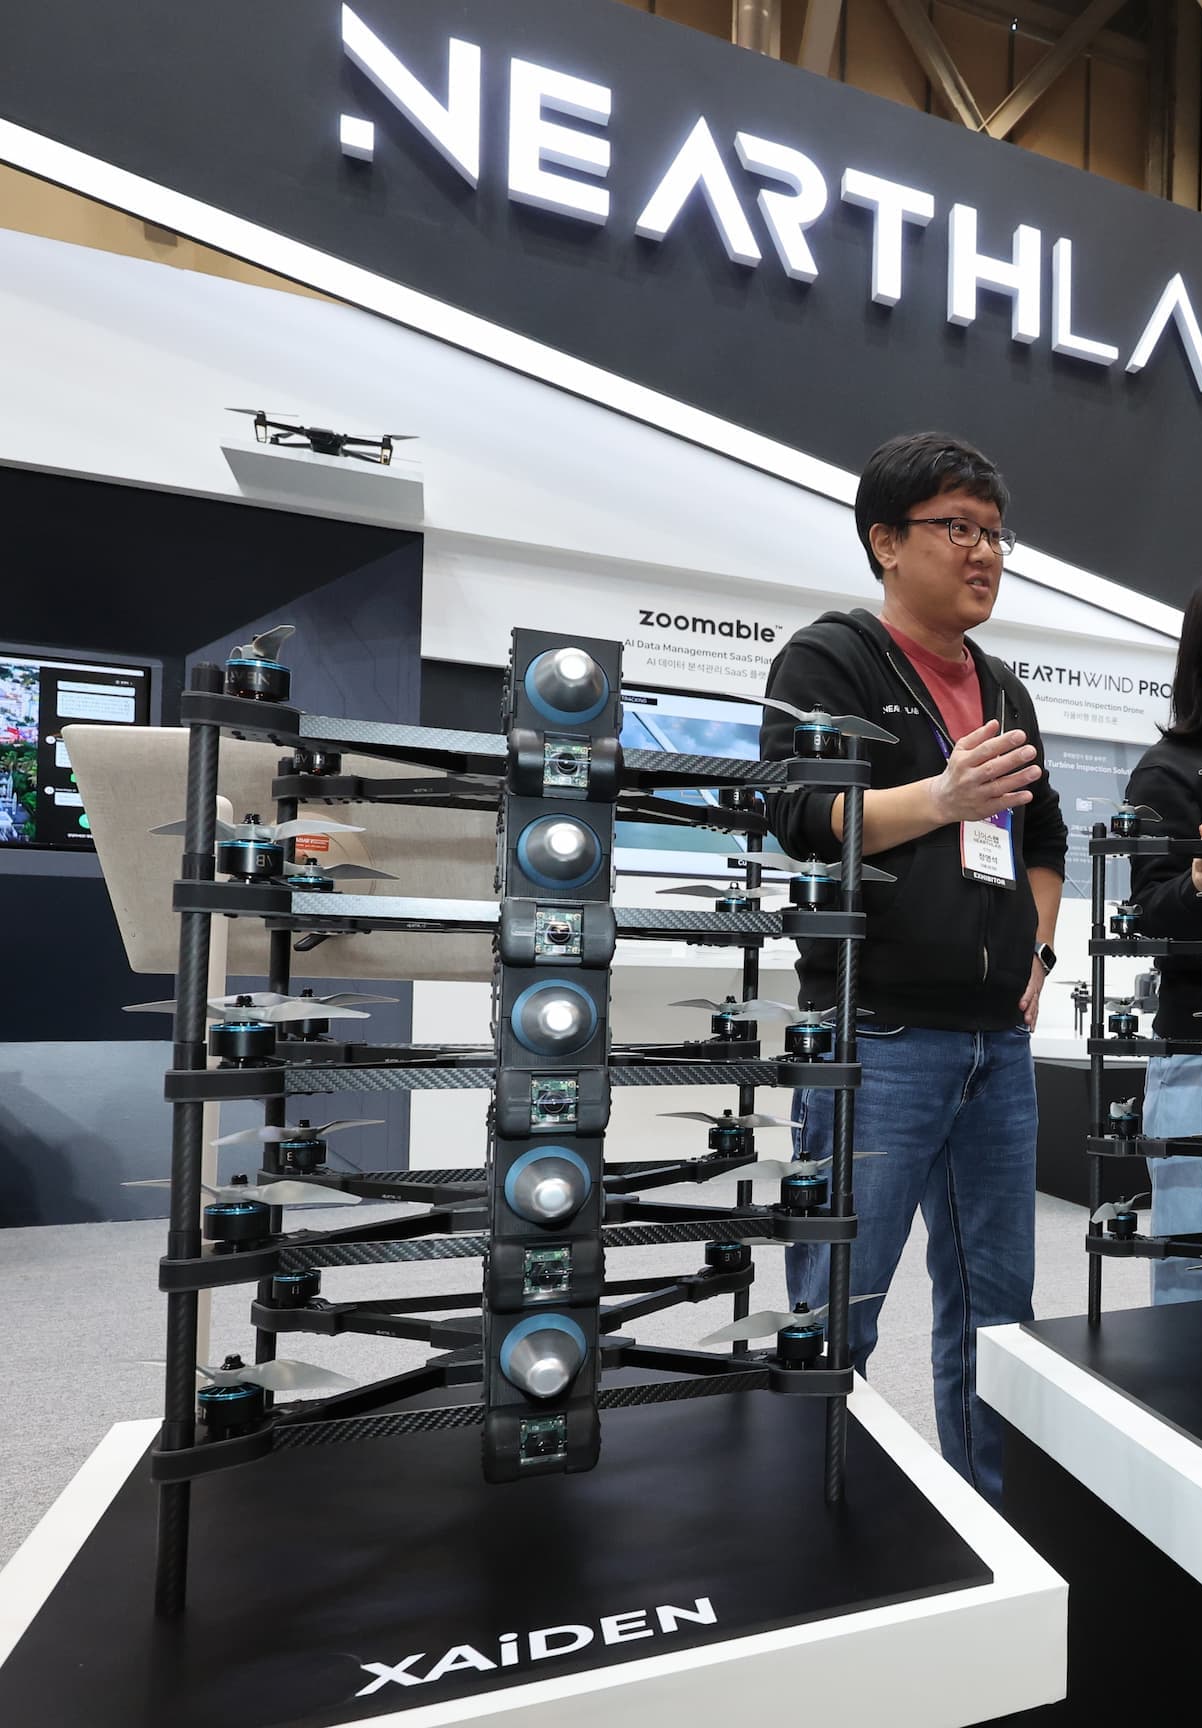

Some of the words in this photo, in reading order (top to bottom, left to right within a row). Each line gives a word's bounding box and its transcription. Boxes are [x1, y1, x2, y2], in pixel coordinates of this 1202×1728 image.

[624, 639, 635, 648] AI
[636, 640, 661, 651] Data
[662, 644, 727, 660] Management
[729, 652, 753, 663] SaaS
[754, 655, 773, 665] Plat
[1138, 680, 1172, 699] PRO
[1035, 694, 1083, 707] Autonomous
[1084, 699, 1122, 712] Inspection
[1123, 705, 1145, 714] Drone
